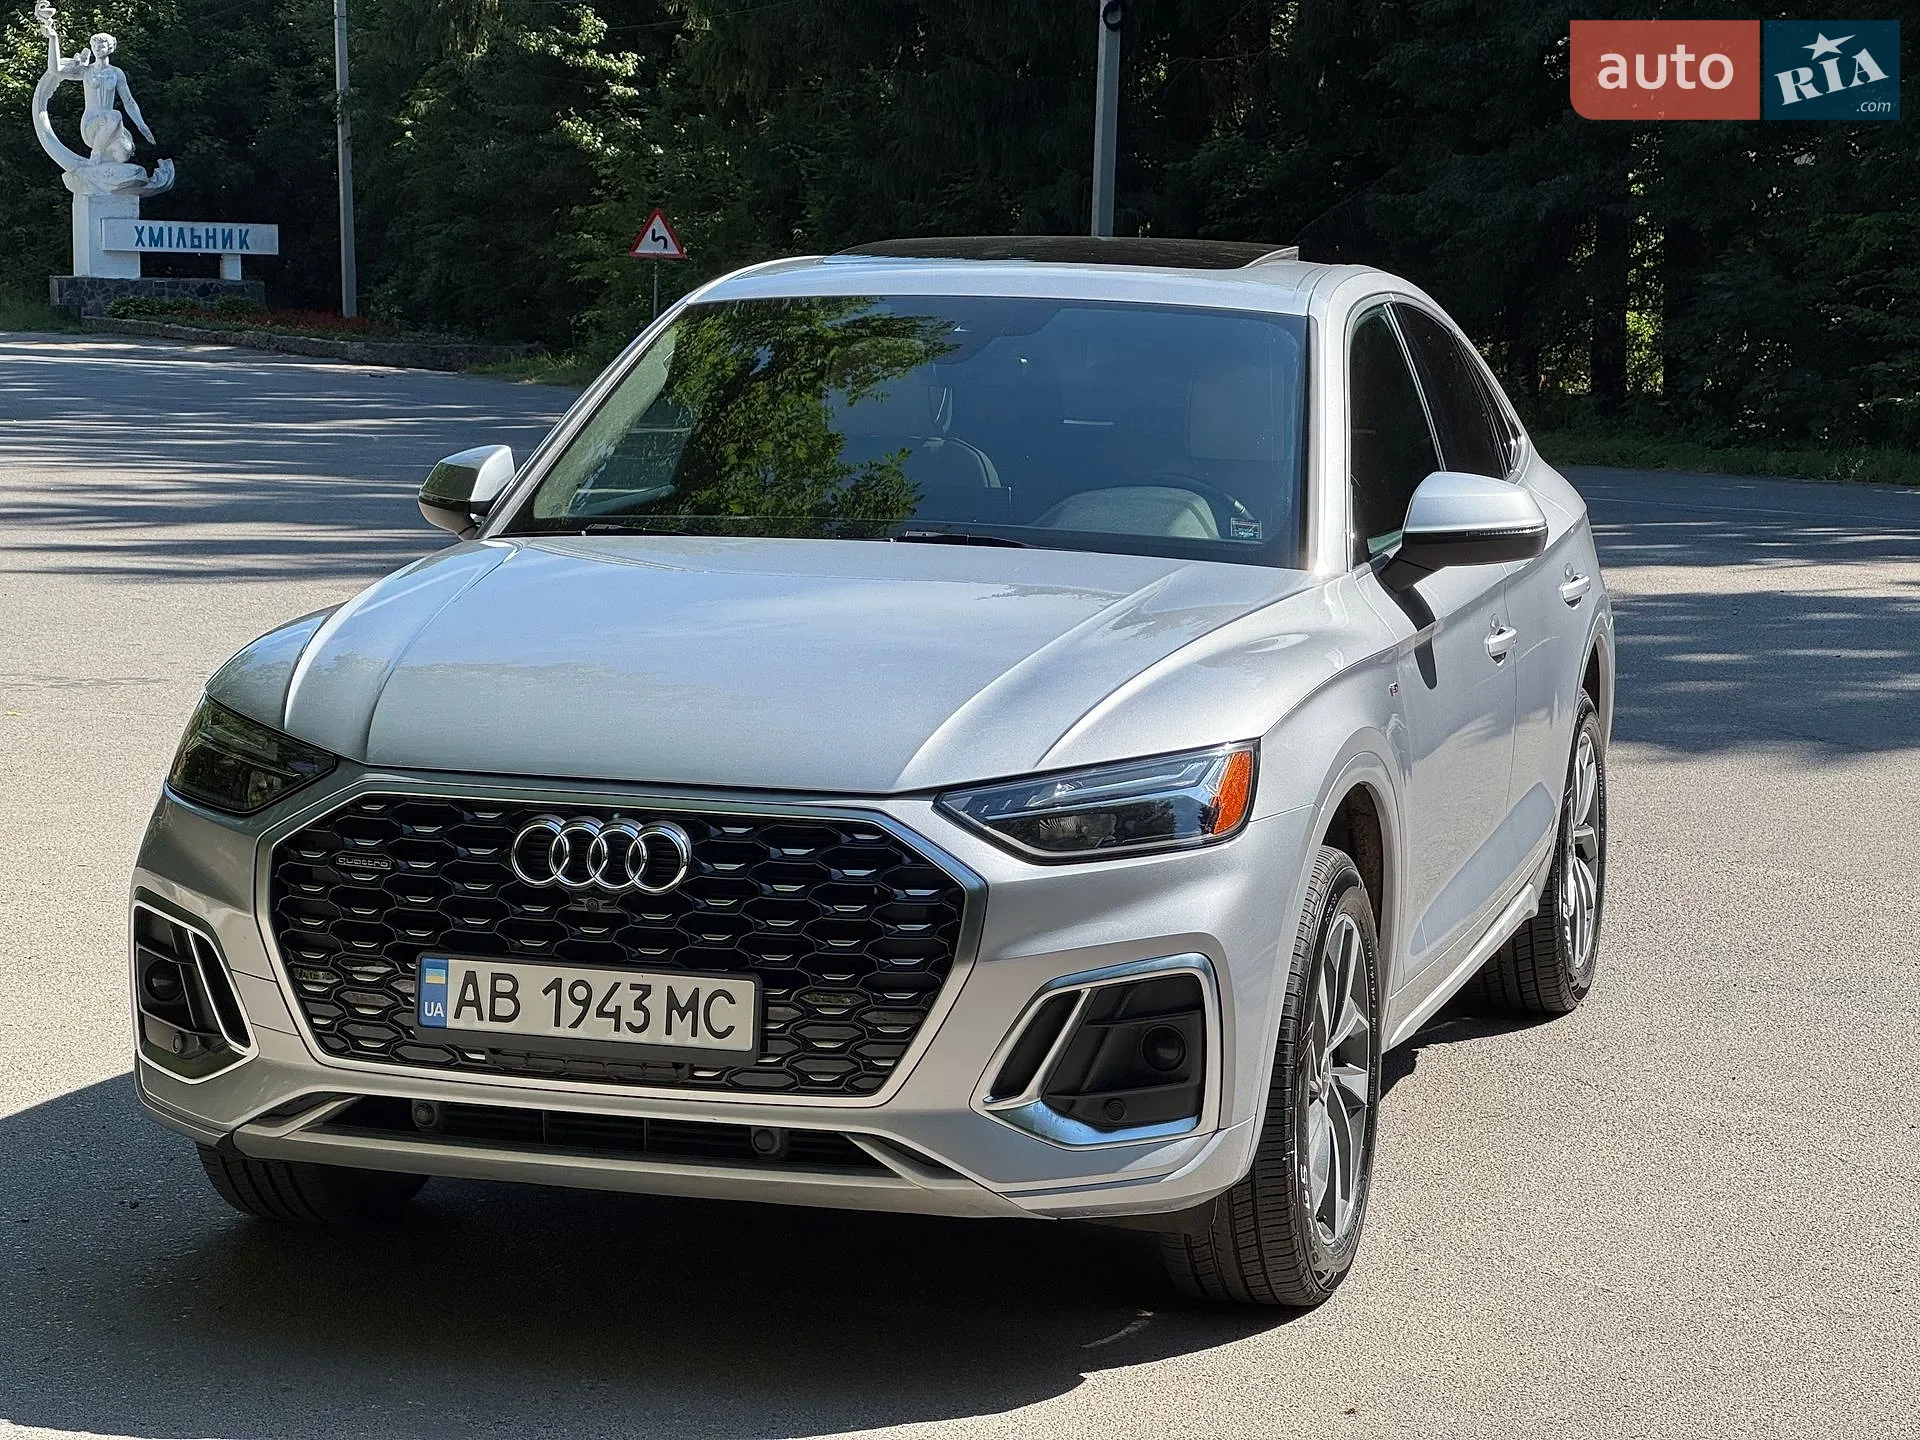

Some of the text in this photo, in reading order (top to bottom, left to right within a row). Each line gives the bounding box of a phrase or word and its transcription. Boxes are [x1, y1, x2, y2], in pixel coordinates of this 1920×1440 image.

[134, 225, 250, 250] ХМІЛЬНИК
[338, 857, 389, 868] quattro
[424, 1001, 444, 1018] UA
[453, 970, 736, 1040] AB 1943 MC
